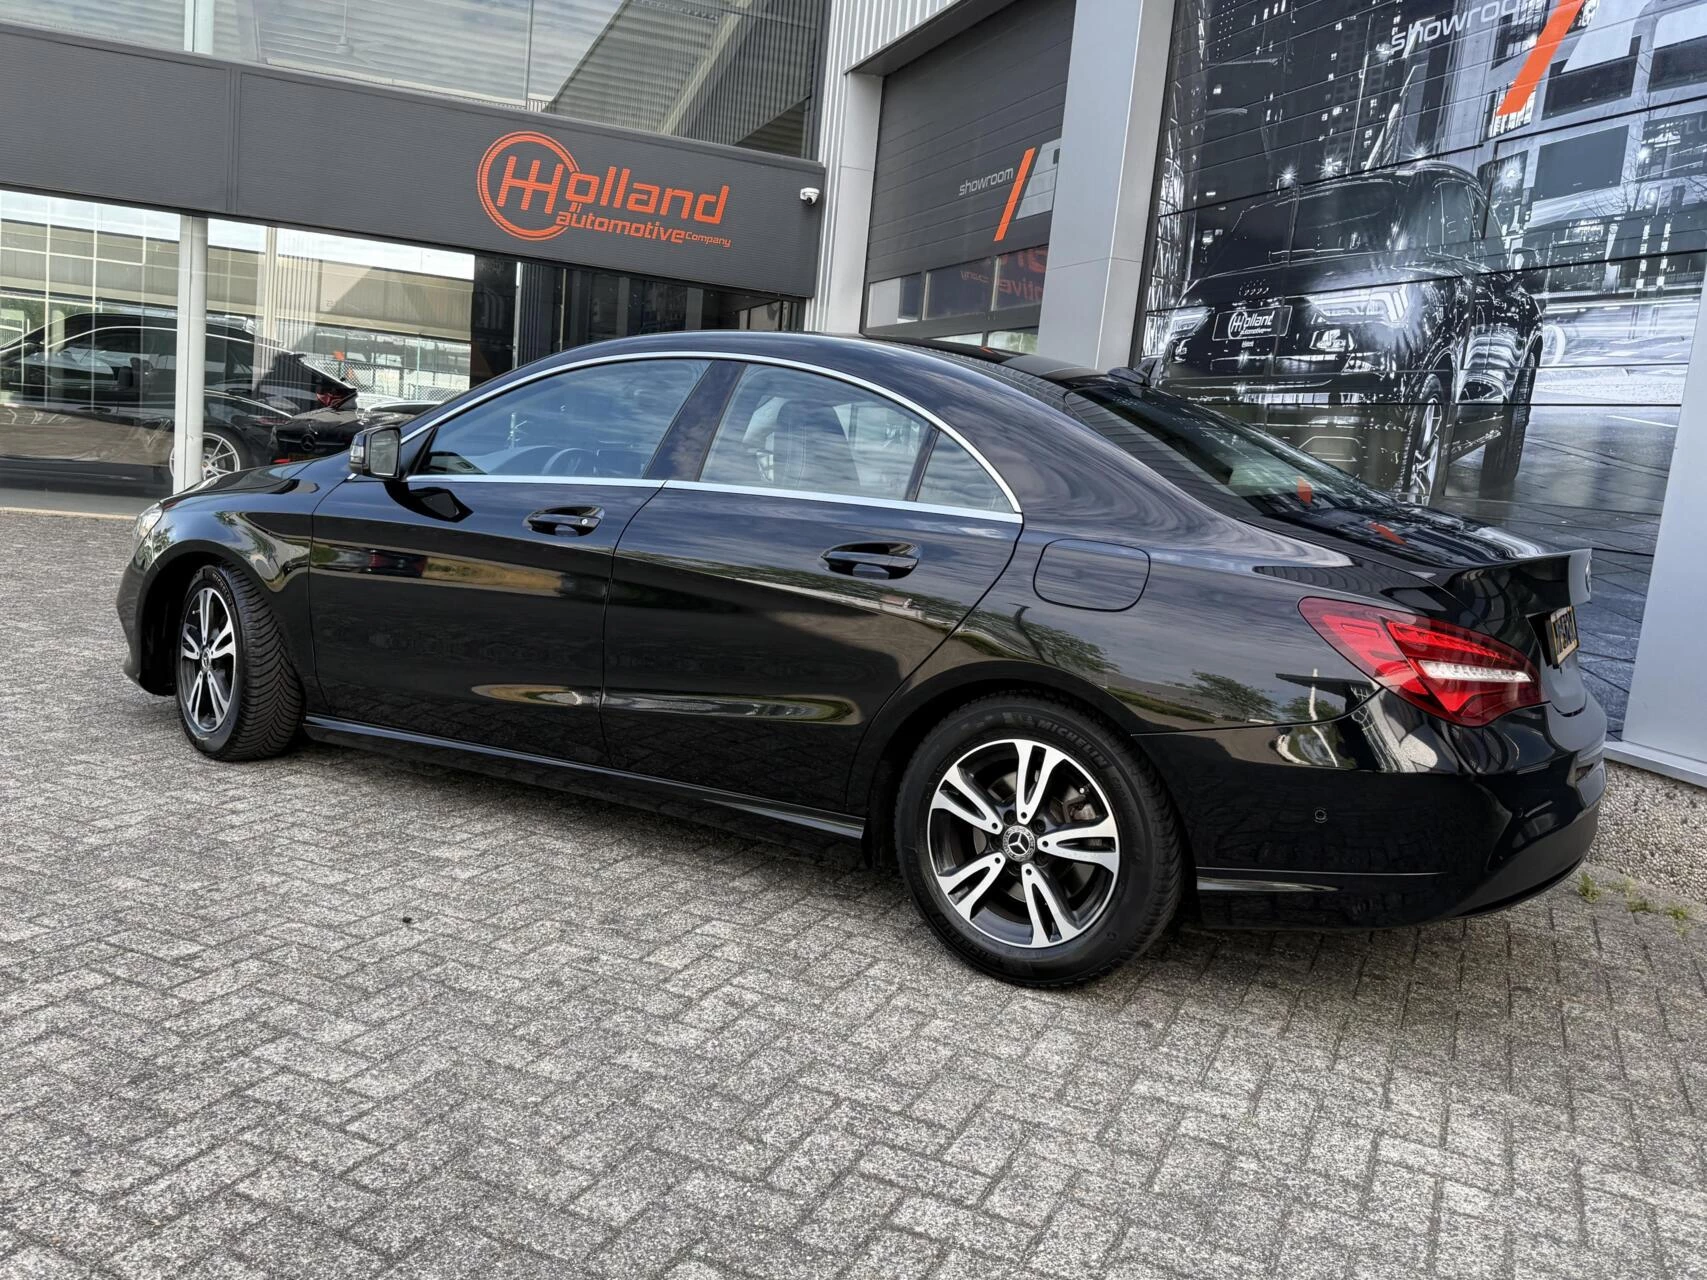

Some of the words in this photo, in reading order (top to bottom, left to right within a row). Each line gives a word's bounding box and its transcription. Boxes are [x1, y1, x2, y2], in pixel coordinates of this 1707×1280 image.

[497, 155, 730, 224] Holland
[959, 168, 1013, 196] showroom
[555, 209, 686, 243] automotive
[686, 231, 732, 248] Company
[1037, 720, 1108, 766] MICHELIN
